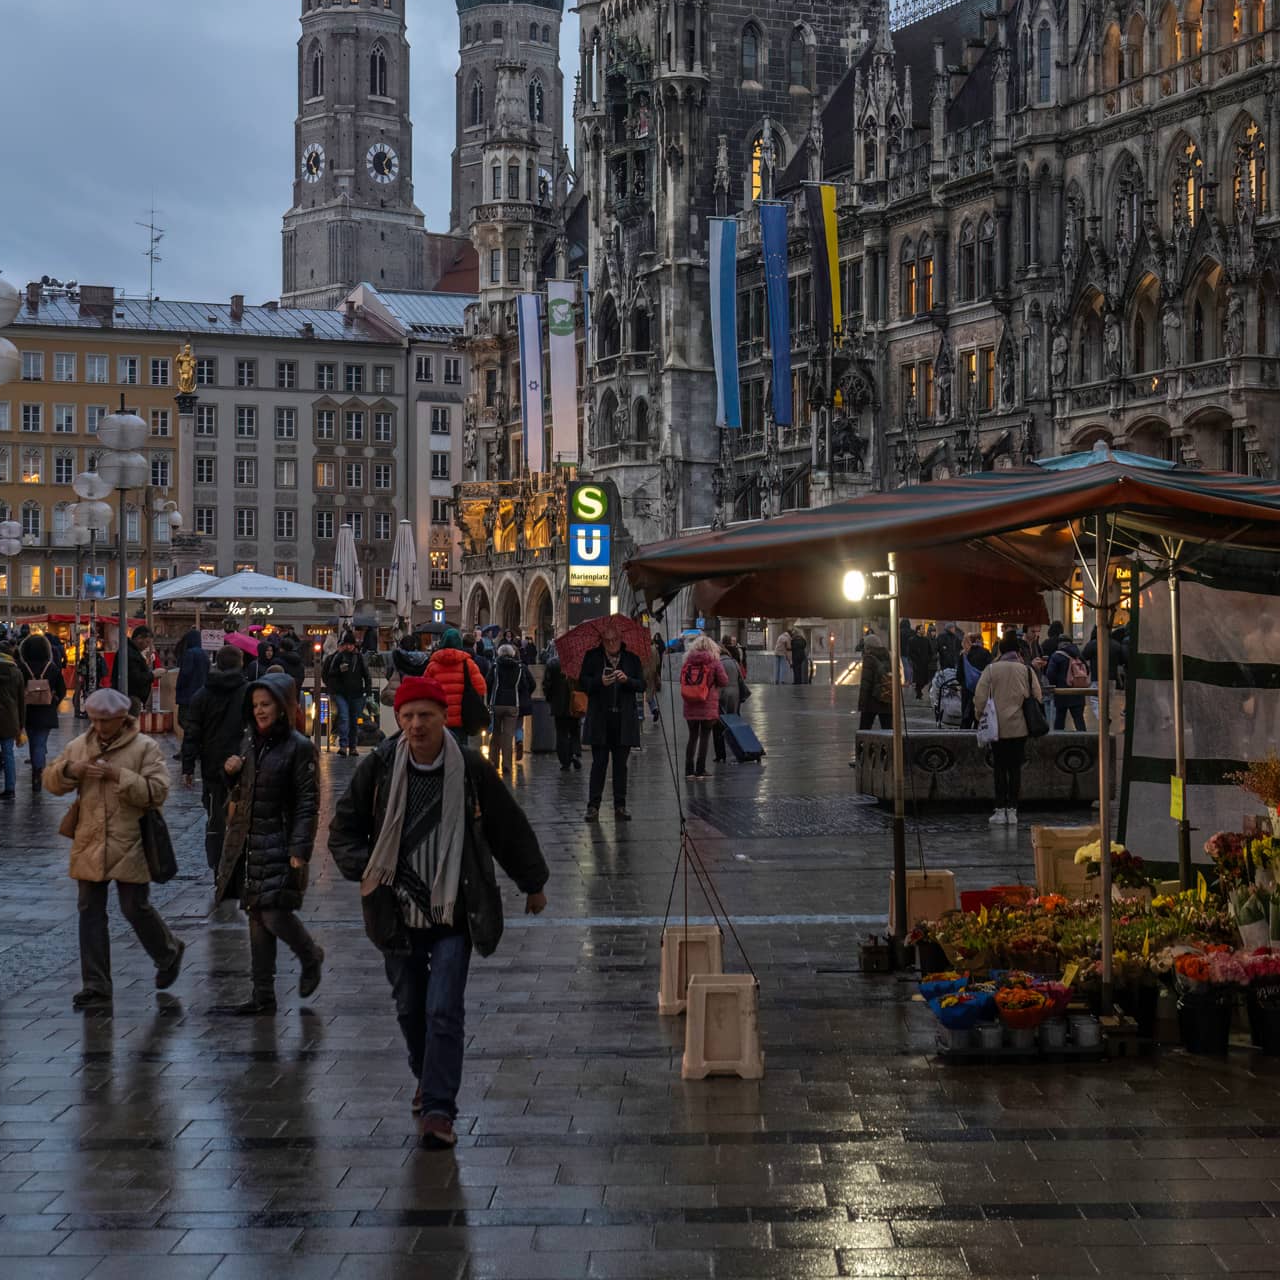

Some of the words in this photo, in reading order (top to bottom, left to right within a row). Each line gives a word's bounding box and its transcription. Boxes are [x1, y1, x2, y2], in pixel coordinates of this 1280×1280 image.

[577, 487, 603, 519] S
[576, 529, 601, 561] U
[570, 572, 609, 582] Marienplatz
[434, 599, 444, 610] S
[434, 611, 443, 623] U
